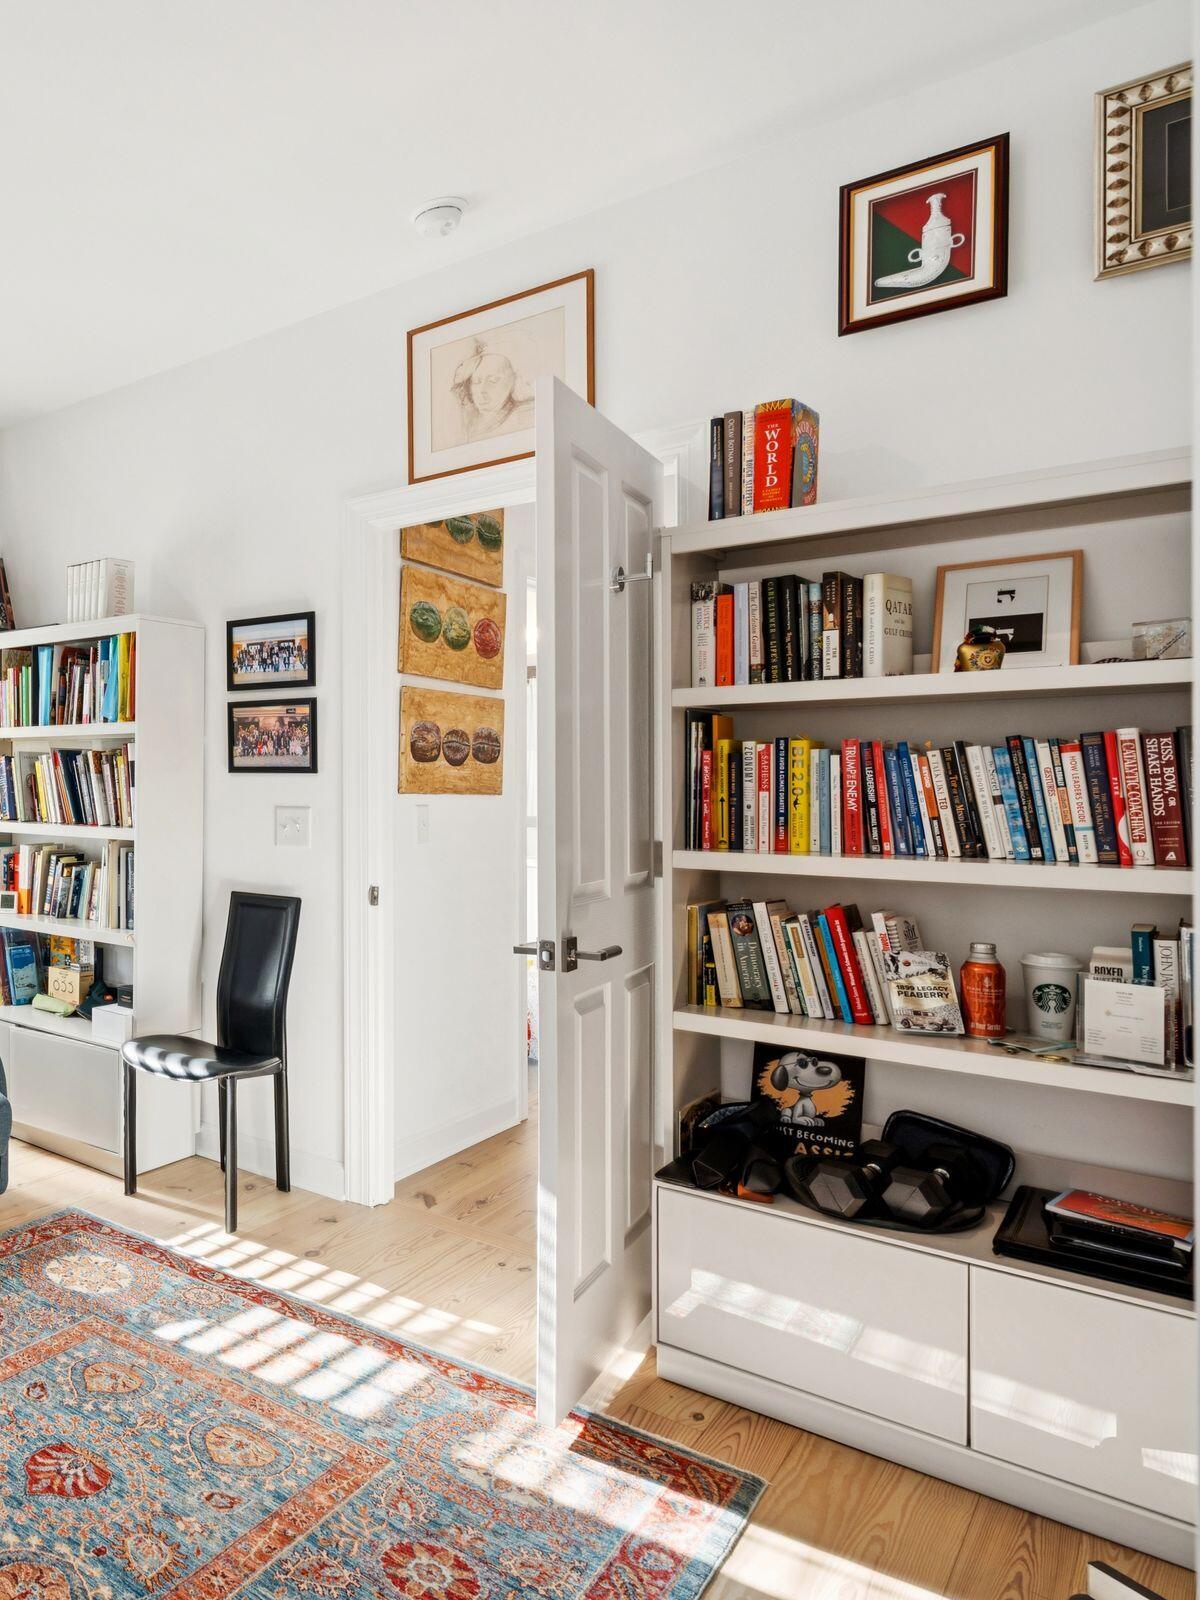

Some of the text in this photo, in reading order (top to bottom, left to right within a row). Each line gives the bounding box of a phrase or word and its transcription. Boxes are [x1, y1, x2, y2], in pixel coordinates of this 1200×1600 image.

[765, 428, 781, 487] WORLD
[768, 604, 776, 633] ZIMMER
[886, 600, 912, 616] QATAR
[884, 628, 898, 636] GULF
[744, 746, 753, 784] ZCONOMY
[792, 746, 804, 796] BE 2.0
[846, 746, 856, 775] TRUMP
[1056, 766, 1064, 787] GLOBALLY
[1146, 738, 1165, 816] SHAKE HANDS
[1160, 737, 1176, 806] KISS, BOW, OR
[846, 780, 858, 811] ENEMY
[865, 767, 876, 802] LEADERSHIP
[902, 758, 916, 817] crucial accountability
[932, 761, 940, 778] TALK
[939, 798, 948, 810] TED
[944, 748, 953, 762] LIFE
[950, 774, 959, 788] TOP
[956, 804, 965, 821] MIND
[974, 765, 990, 820] WISDOM WORK
[988, 769, 999, 792] Secret
[1018, 781, 1026, 804] AMERICAN
[1044, 767, 1055, 797] GESTURES
[1070, 756, 1085, 823] HOW LEADERS DECIDE
[1122, 742, 1146, 840] CATALYTIC COACHING
[1090, 779, 1104, 834] PUBLIC SPEAKING
[808, 941, 816, 956] THEORY
[837, 925, 846, 942] geworden
[737, 942, 752, 989] in America
[748, 942, 762, 990] Democracy
[1158, 945, 1174, 972] JOHN
[772, 973, 780, 992] HUMAN
[898, 991, 950, 999] PEABERRY
[796, 1130, 854, 1148] BECOMING
